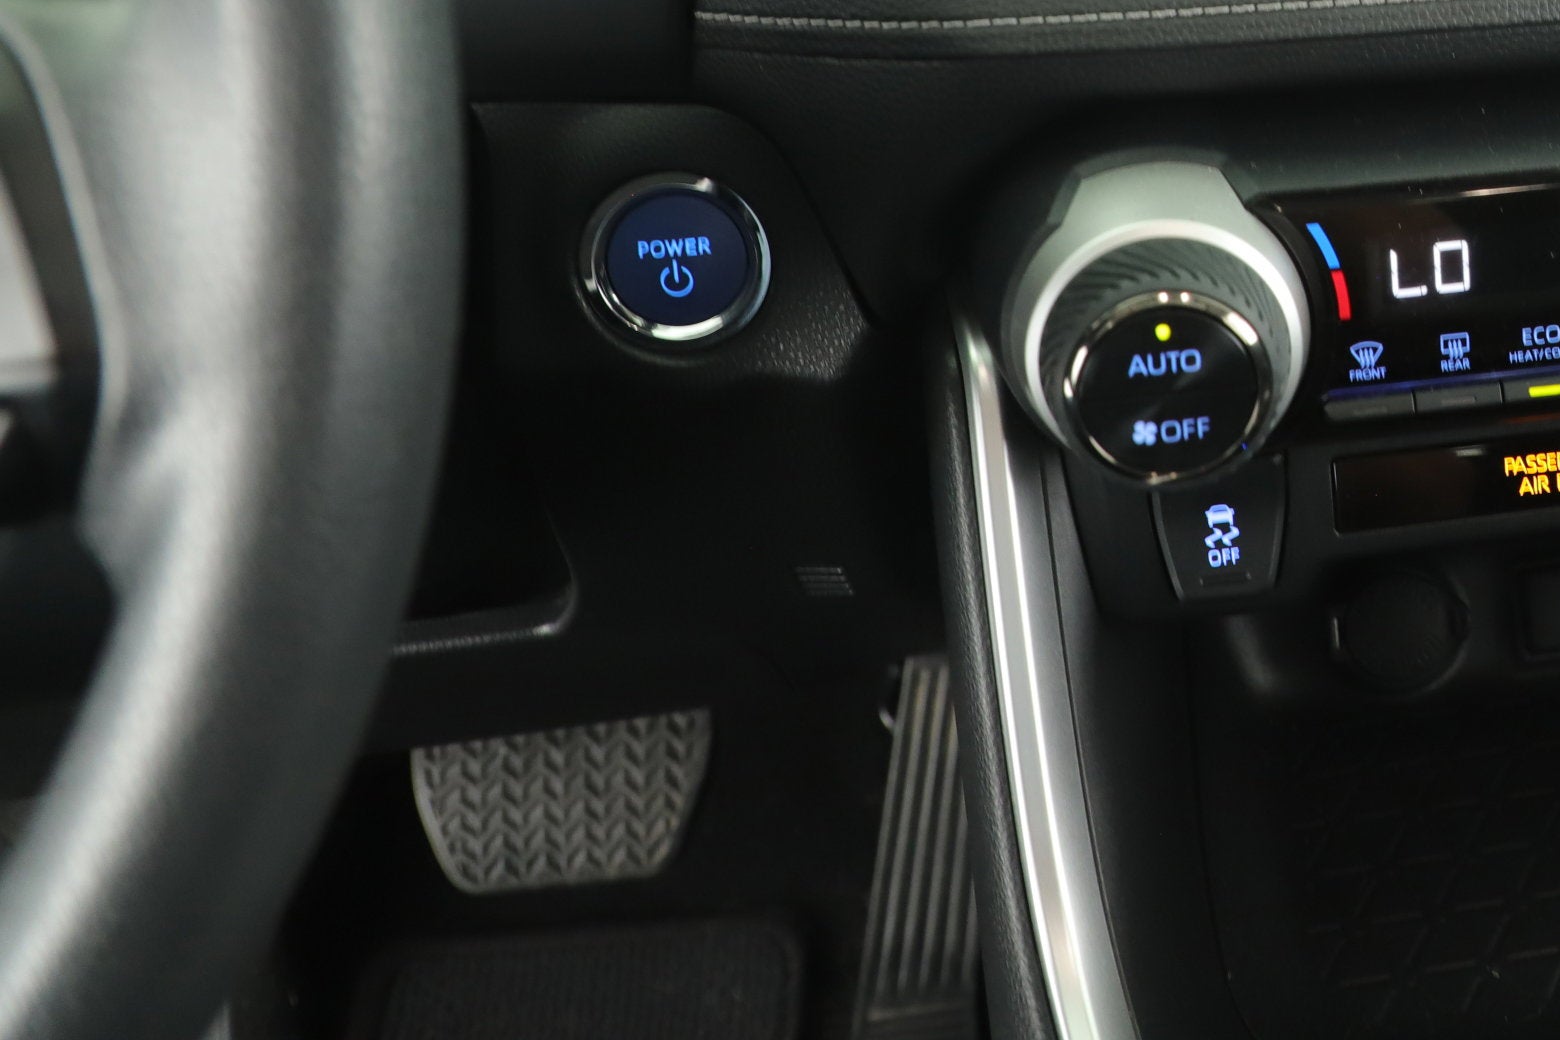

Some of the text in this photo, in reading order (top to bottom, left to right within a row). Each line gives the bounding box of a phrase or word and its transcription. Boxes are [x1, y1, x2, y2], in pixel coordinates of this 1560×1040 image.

[637, 236, 712, 259] POWER
[1389, 239, 1471, 299] LO
[1128, 348, 1202, 378] AUTO
[1349, 366, 1387, 383] FRONT
[1441, 359, 1471, 373] REAR
[1160, 416, 1211, 443] OFF
[1519, 474, 1551, 497] AIR
[1208, 547, 1240, 568] OFF
